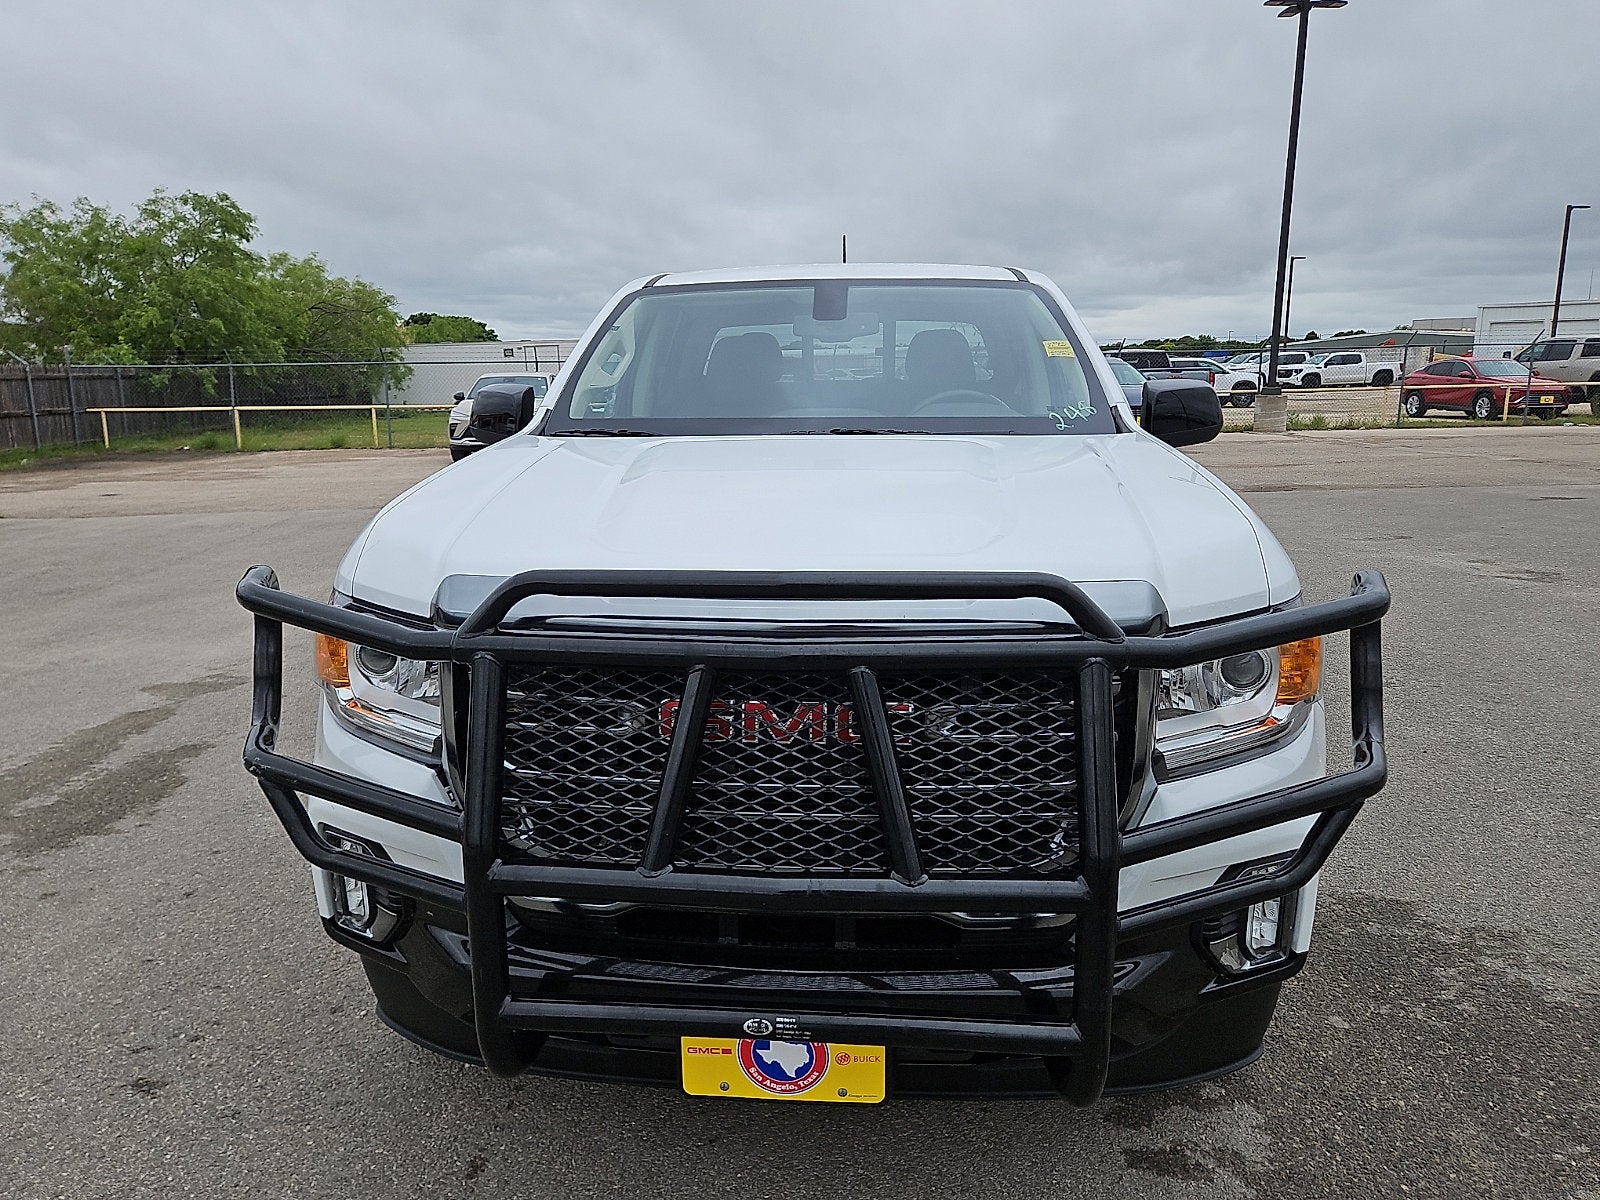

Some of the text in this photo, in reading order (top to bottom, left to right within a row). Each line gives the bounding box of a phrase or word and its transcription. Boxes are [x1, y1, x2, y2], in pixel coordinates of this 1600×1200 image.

[658, 699, 913, 745] GMC
[687, 1047, 721, 1055] GMC
[853, 1055, 881, 1063] BUICK
[748, 1066, 820, 1091] San Angelo, Texas
